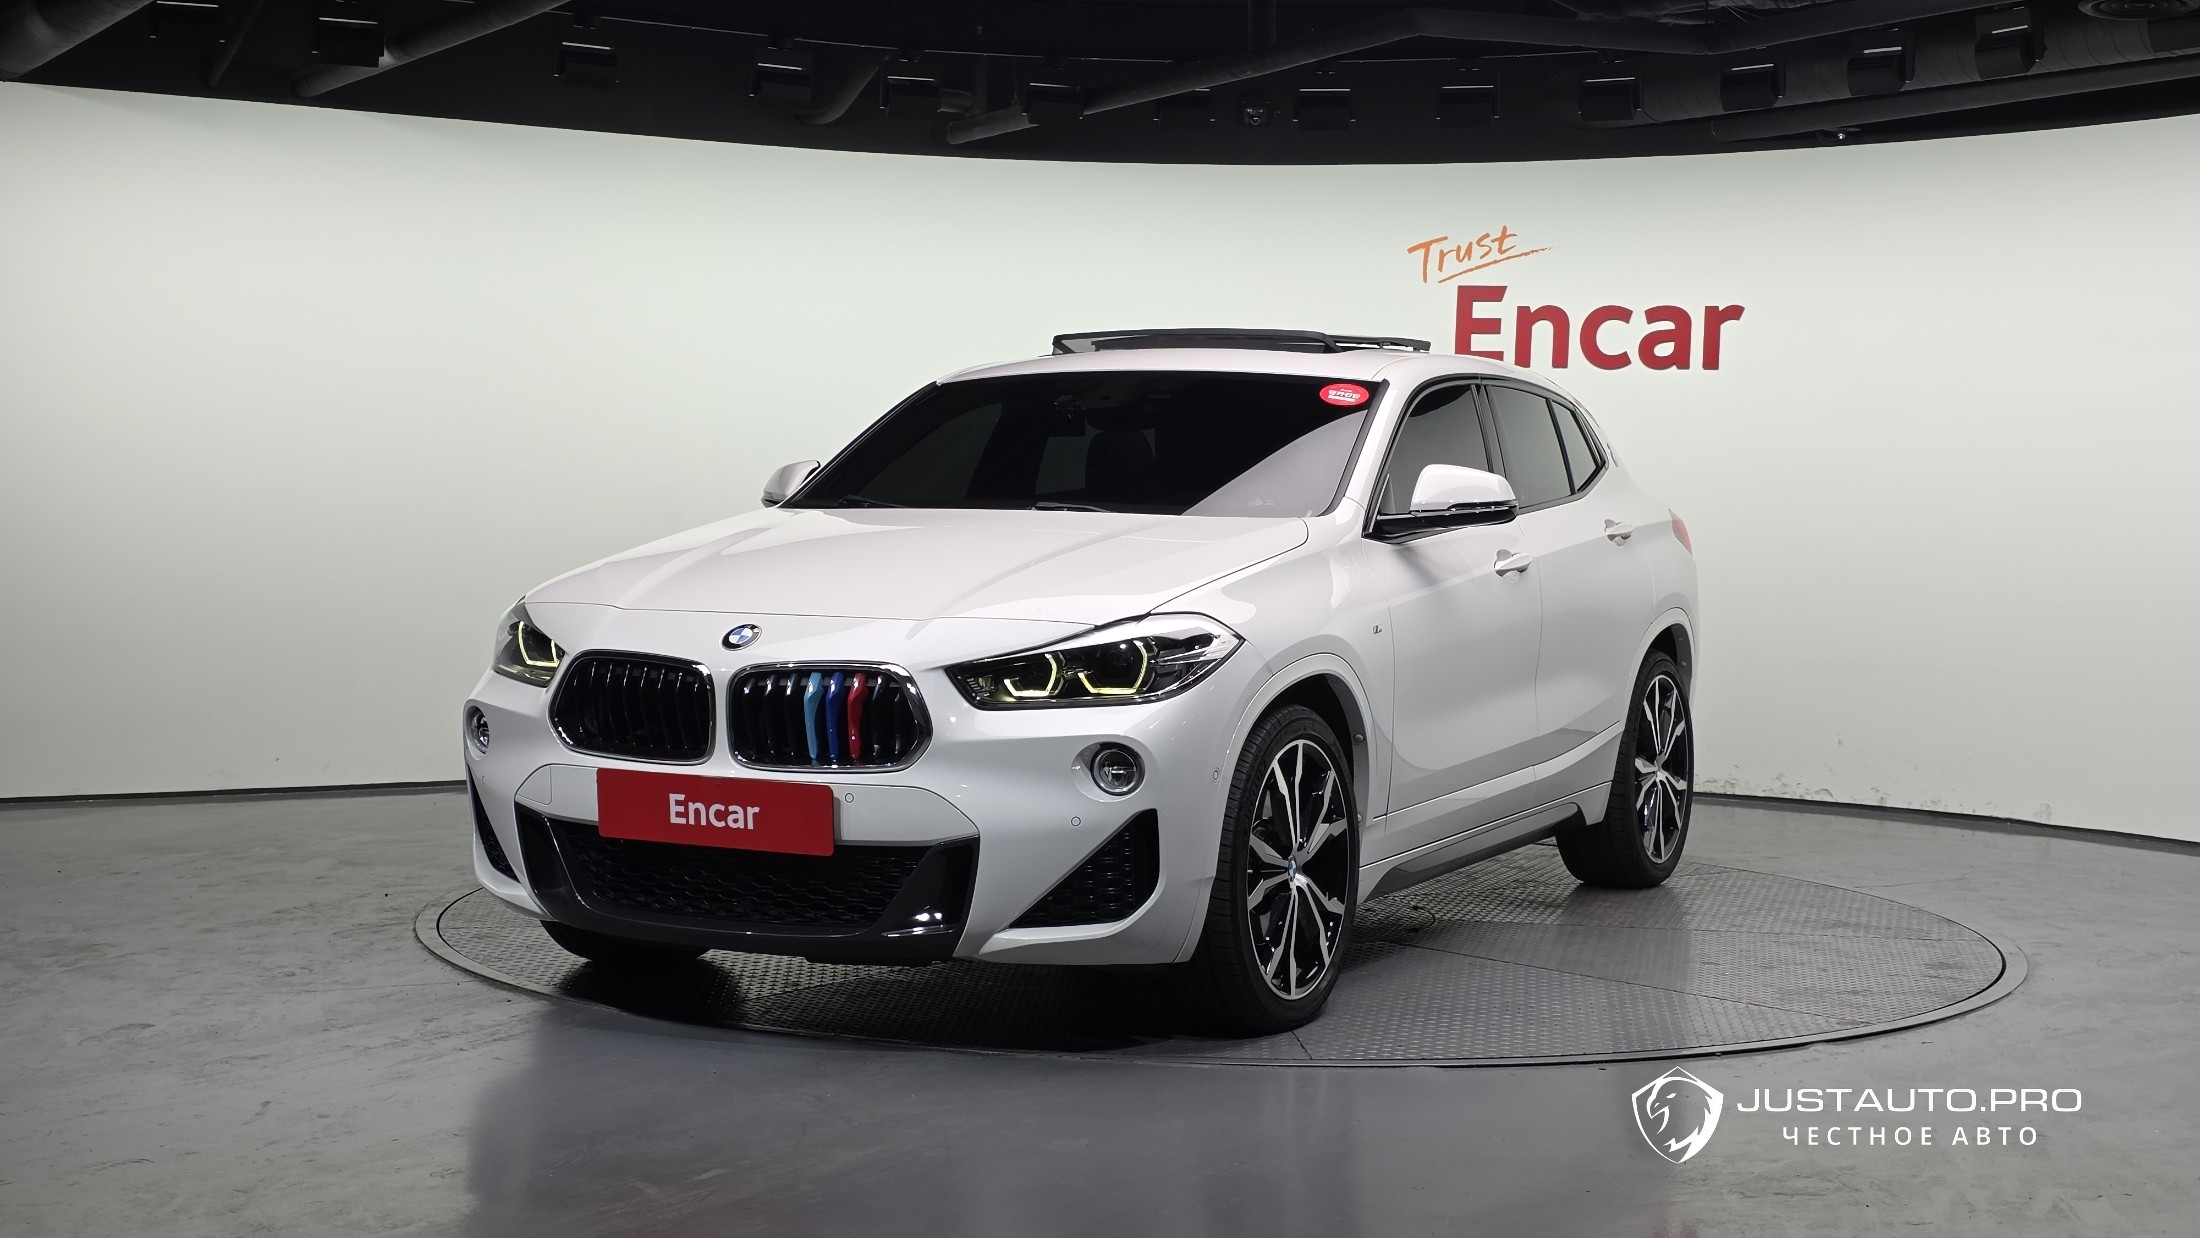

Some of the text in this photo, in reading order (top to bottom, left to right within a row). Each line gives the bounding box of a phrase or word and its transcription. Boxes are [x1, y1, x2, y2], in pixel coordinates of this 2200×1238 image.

[1407, 225, 1518, 284] Trust
[1455, 285, 1745, 370] Encar
[669, 793, 760, 830] Encar
